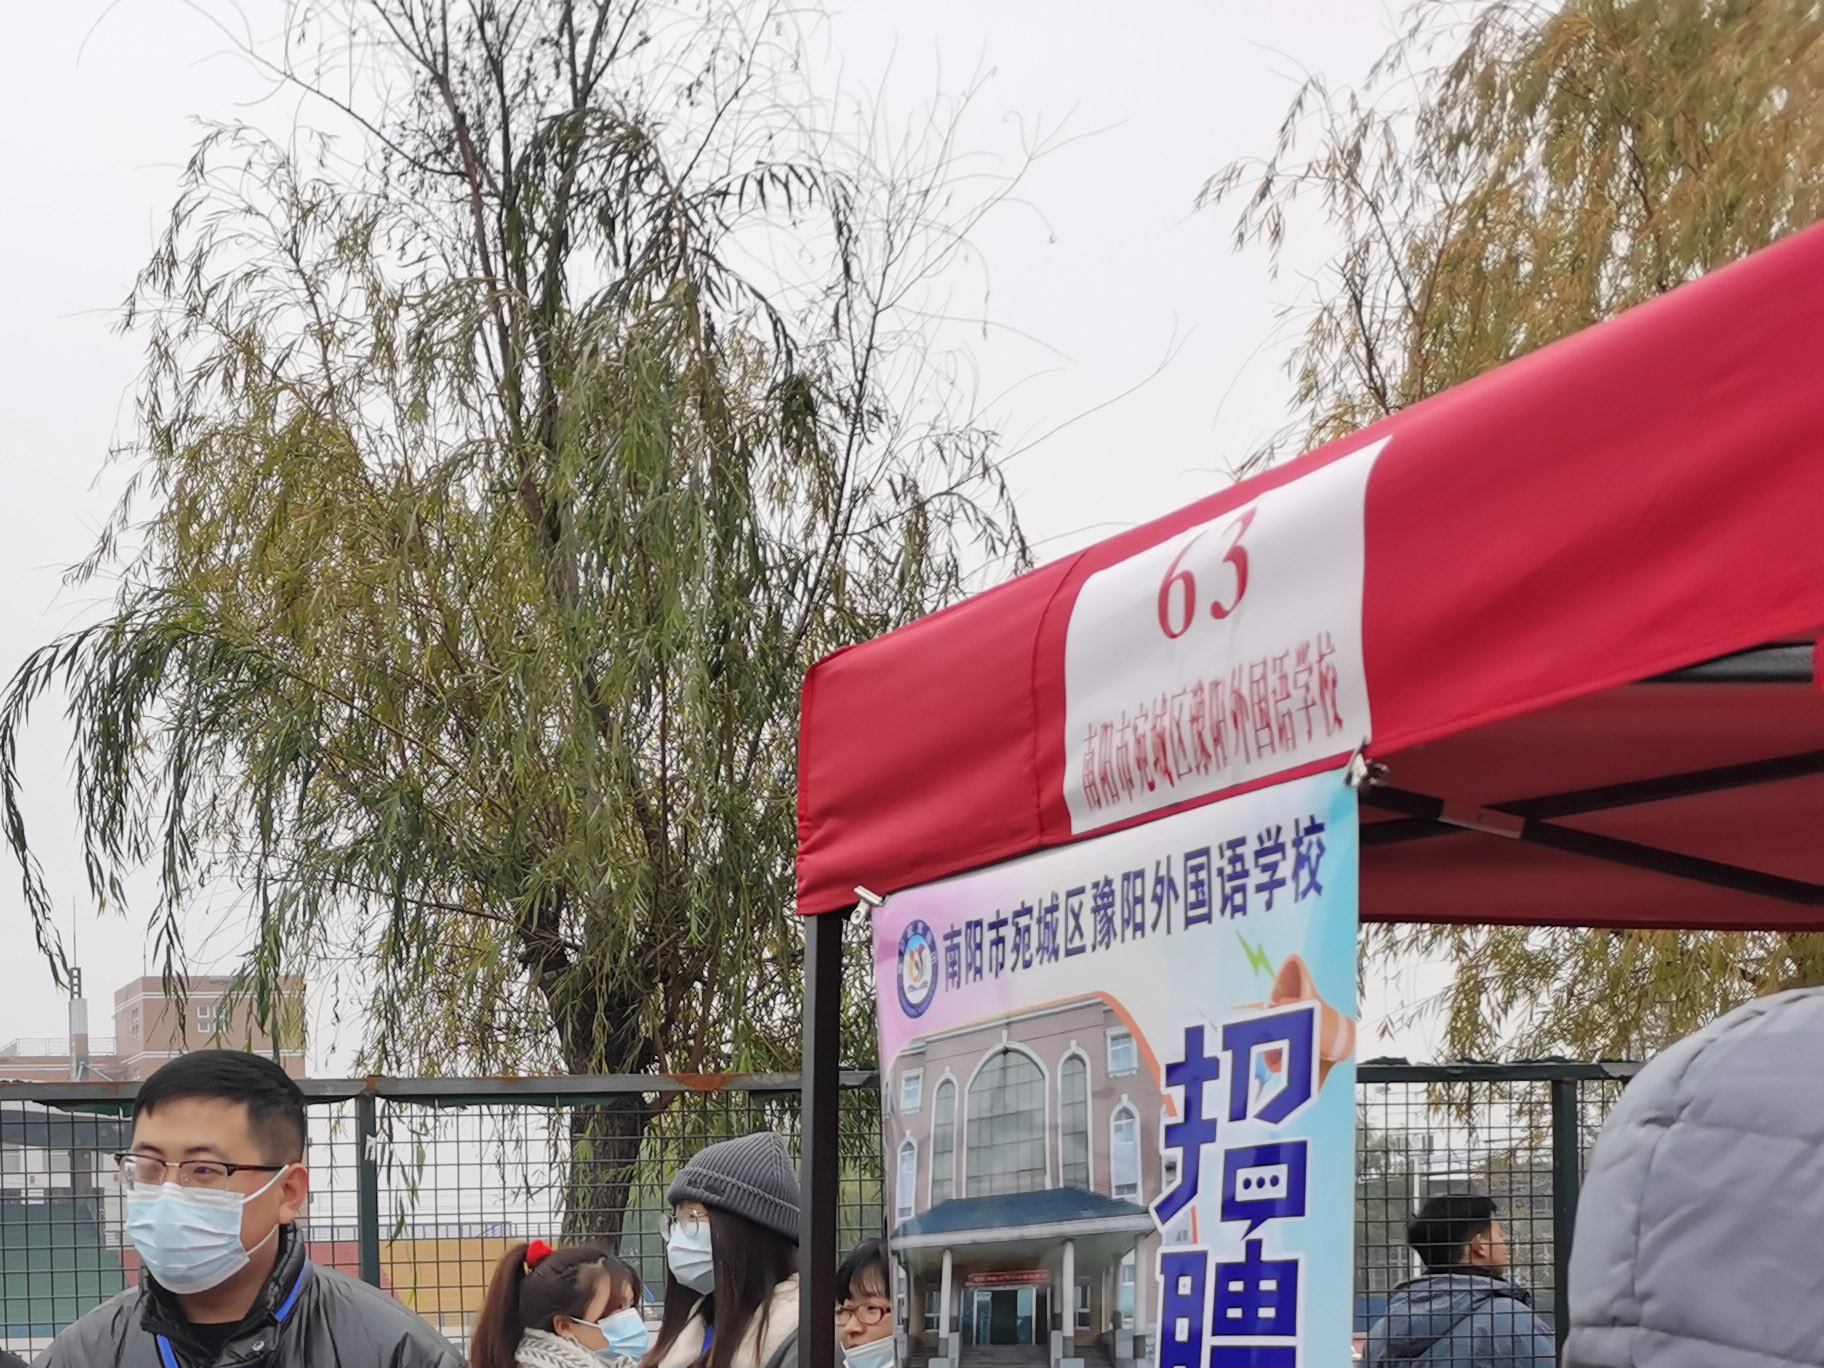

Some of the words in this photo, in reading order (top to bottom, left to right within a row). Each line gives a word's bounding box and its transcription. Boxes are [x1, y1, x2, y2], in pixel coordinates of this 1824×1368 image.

[1158, 507, 1258, 639] 63
[1082, 629, 1344, 811] 南阳市宛城区豫阳外国语学校
[943, 814, 1327, 992] 南阳市宛城区豫阳外国语学校
